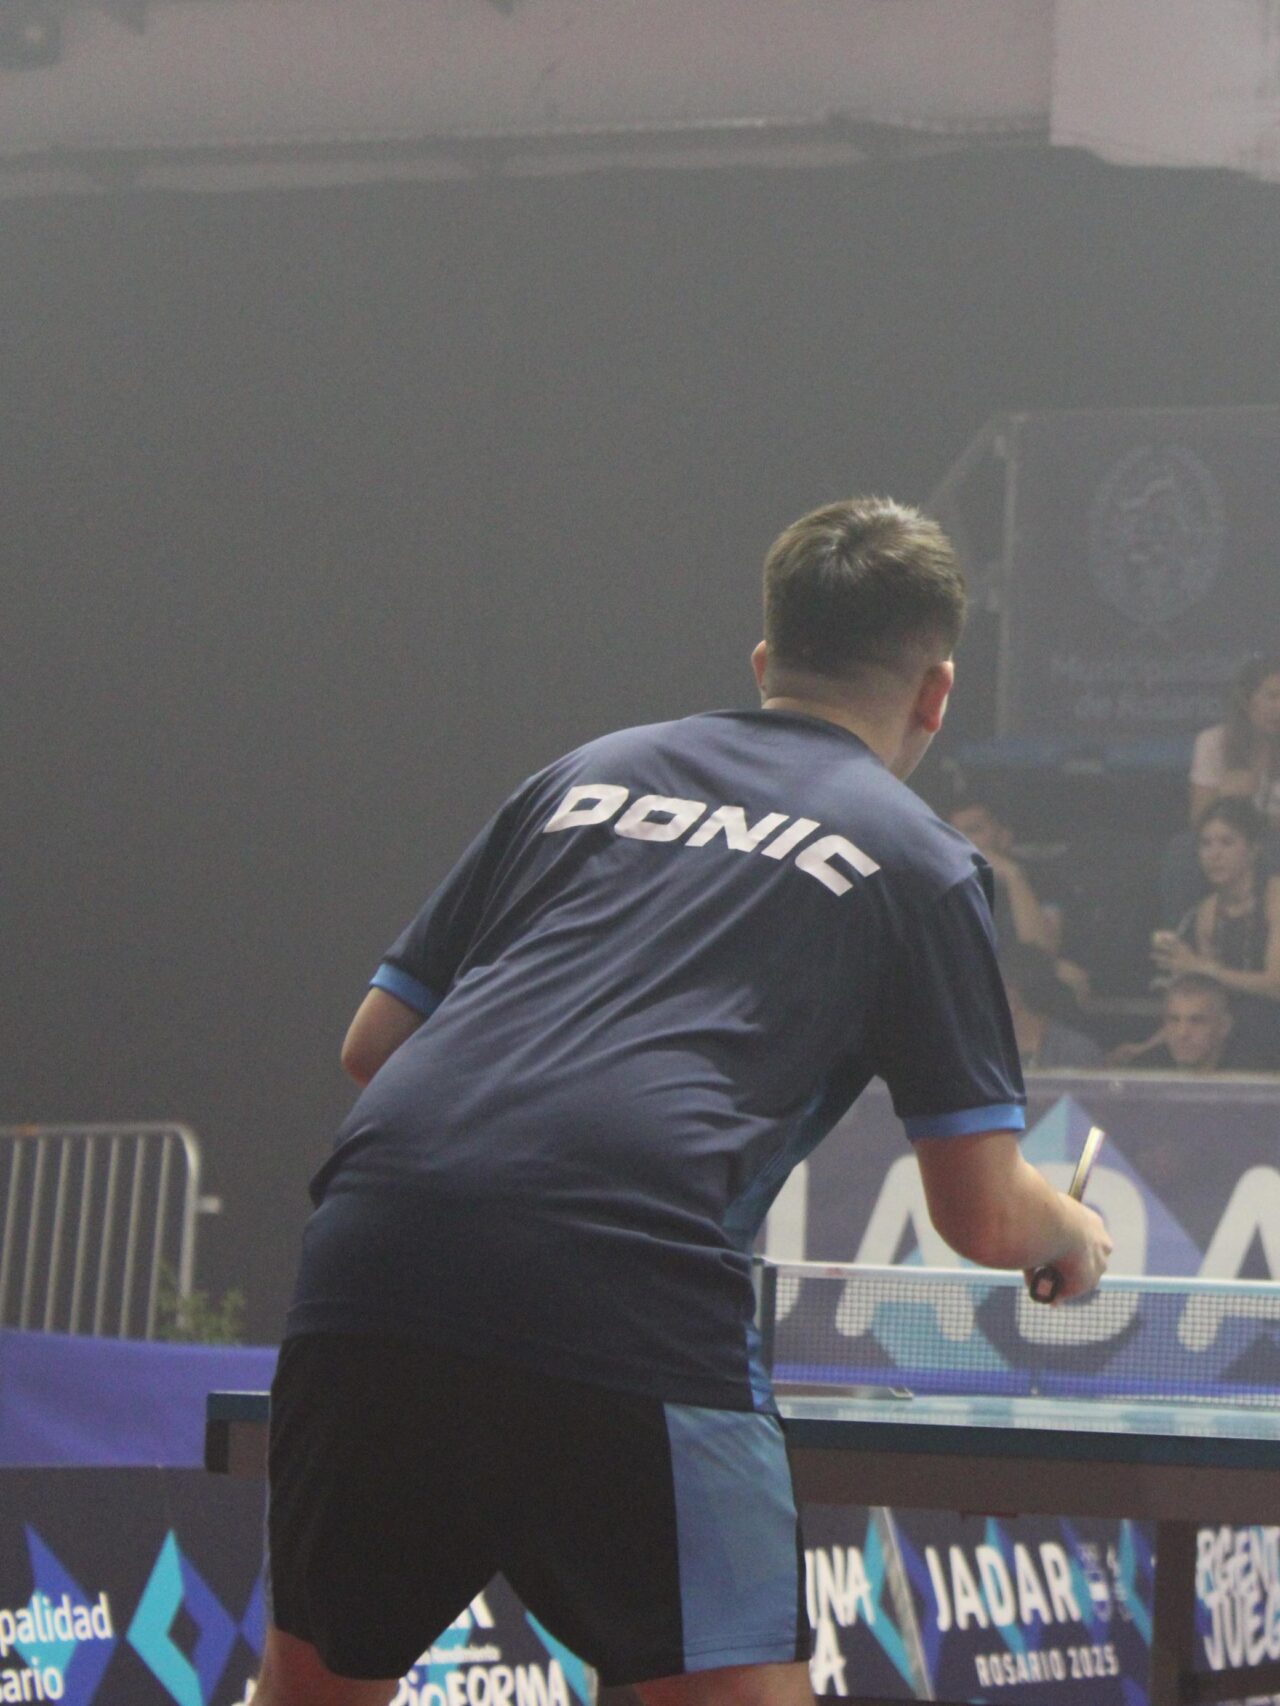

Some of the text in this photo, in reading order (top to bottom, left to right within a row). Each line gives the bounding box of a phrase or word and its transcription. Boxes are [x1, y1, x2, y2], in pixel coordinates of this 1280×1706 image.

[543, 783, 881, 897] DONIC
[924, 1541, 1082, 1633] JADAR
[0, 1656, 64, 1703] ario
[974, 1645, 1120, 1687] ROSARIO 2025
